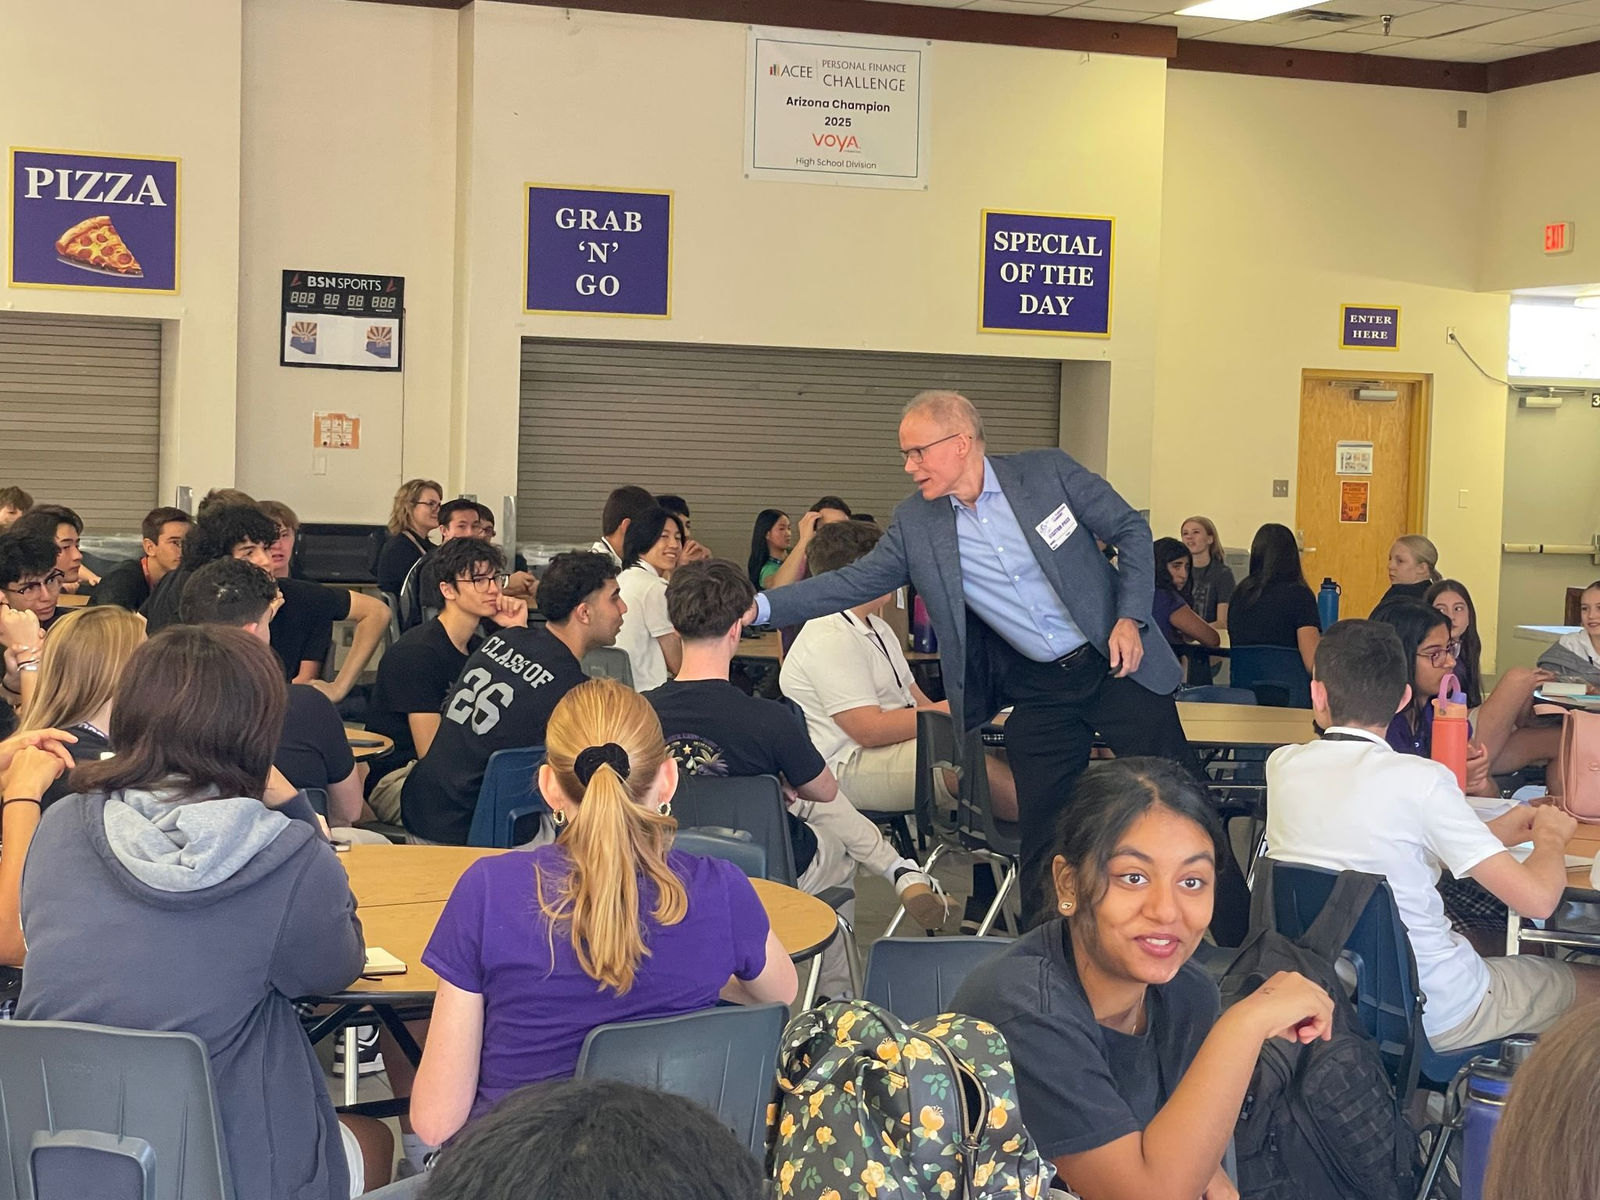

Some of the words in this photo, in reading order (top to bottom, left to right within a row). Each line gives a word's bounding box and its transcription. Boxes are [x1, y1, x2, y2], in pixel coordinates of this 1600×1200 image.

[780, 65, 813, 78] ACEE
[822, 60, 866, 71] PERSONAL
[868, 62, 906, 73] FINANCE
[823, 74, 905, 92] CHALLENGE
[786, 96, 830, 109] Arizona
[832, 100, 890, 114] Champion
[824, 116, 851, 127] 2025
[812, 133, 860, 152] VOYA
[796, 157, 815, 168] High
[817, 158, 844, 167] School
[846, 159, 877, 169] Division
[24, 167, 167, 206] PIZZA
[555, 207, 643, 232] GRAB
[994, 230, 1103, 256] SPECIAL
[1545, 223, 1565, 251] EXIT
[579, 241, 619, 264] ‘N’
[307, 275, 336, 288] BSN
[337, 278, 382, 291] SPORTS
[1000, 262, 1035, 283] OF
[1040, 264, 1094, 286] THE
[576, 274, 620, 296] GO
[1019, 294, 1074, 316] DAY
[1350, 314, 1392, 324] ENTER
[1353, 330, 1388, 339] HERE
[481, 636, 531, 674] CLASS
[523, 663, 555, 689] OF
[446, 667, 514, 736] 26
